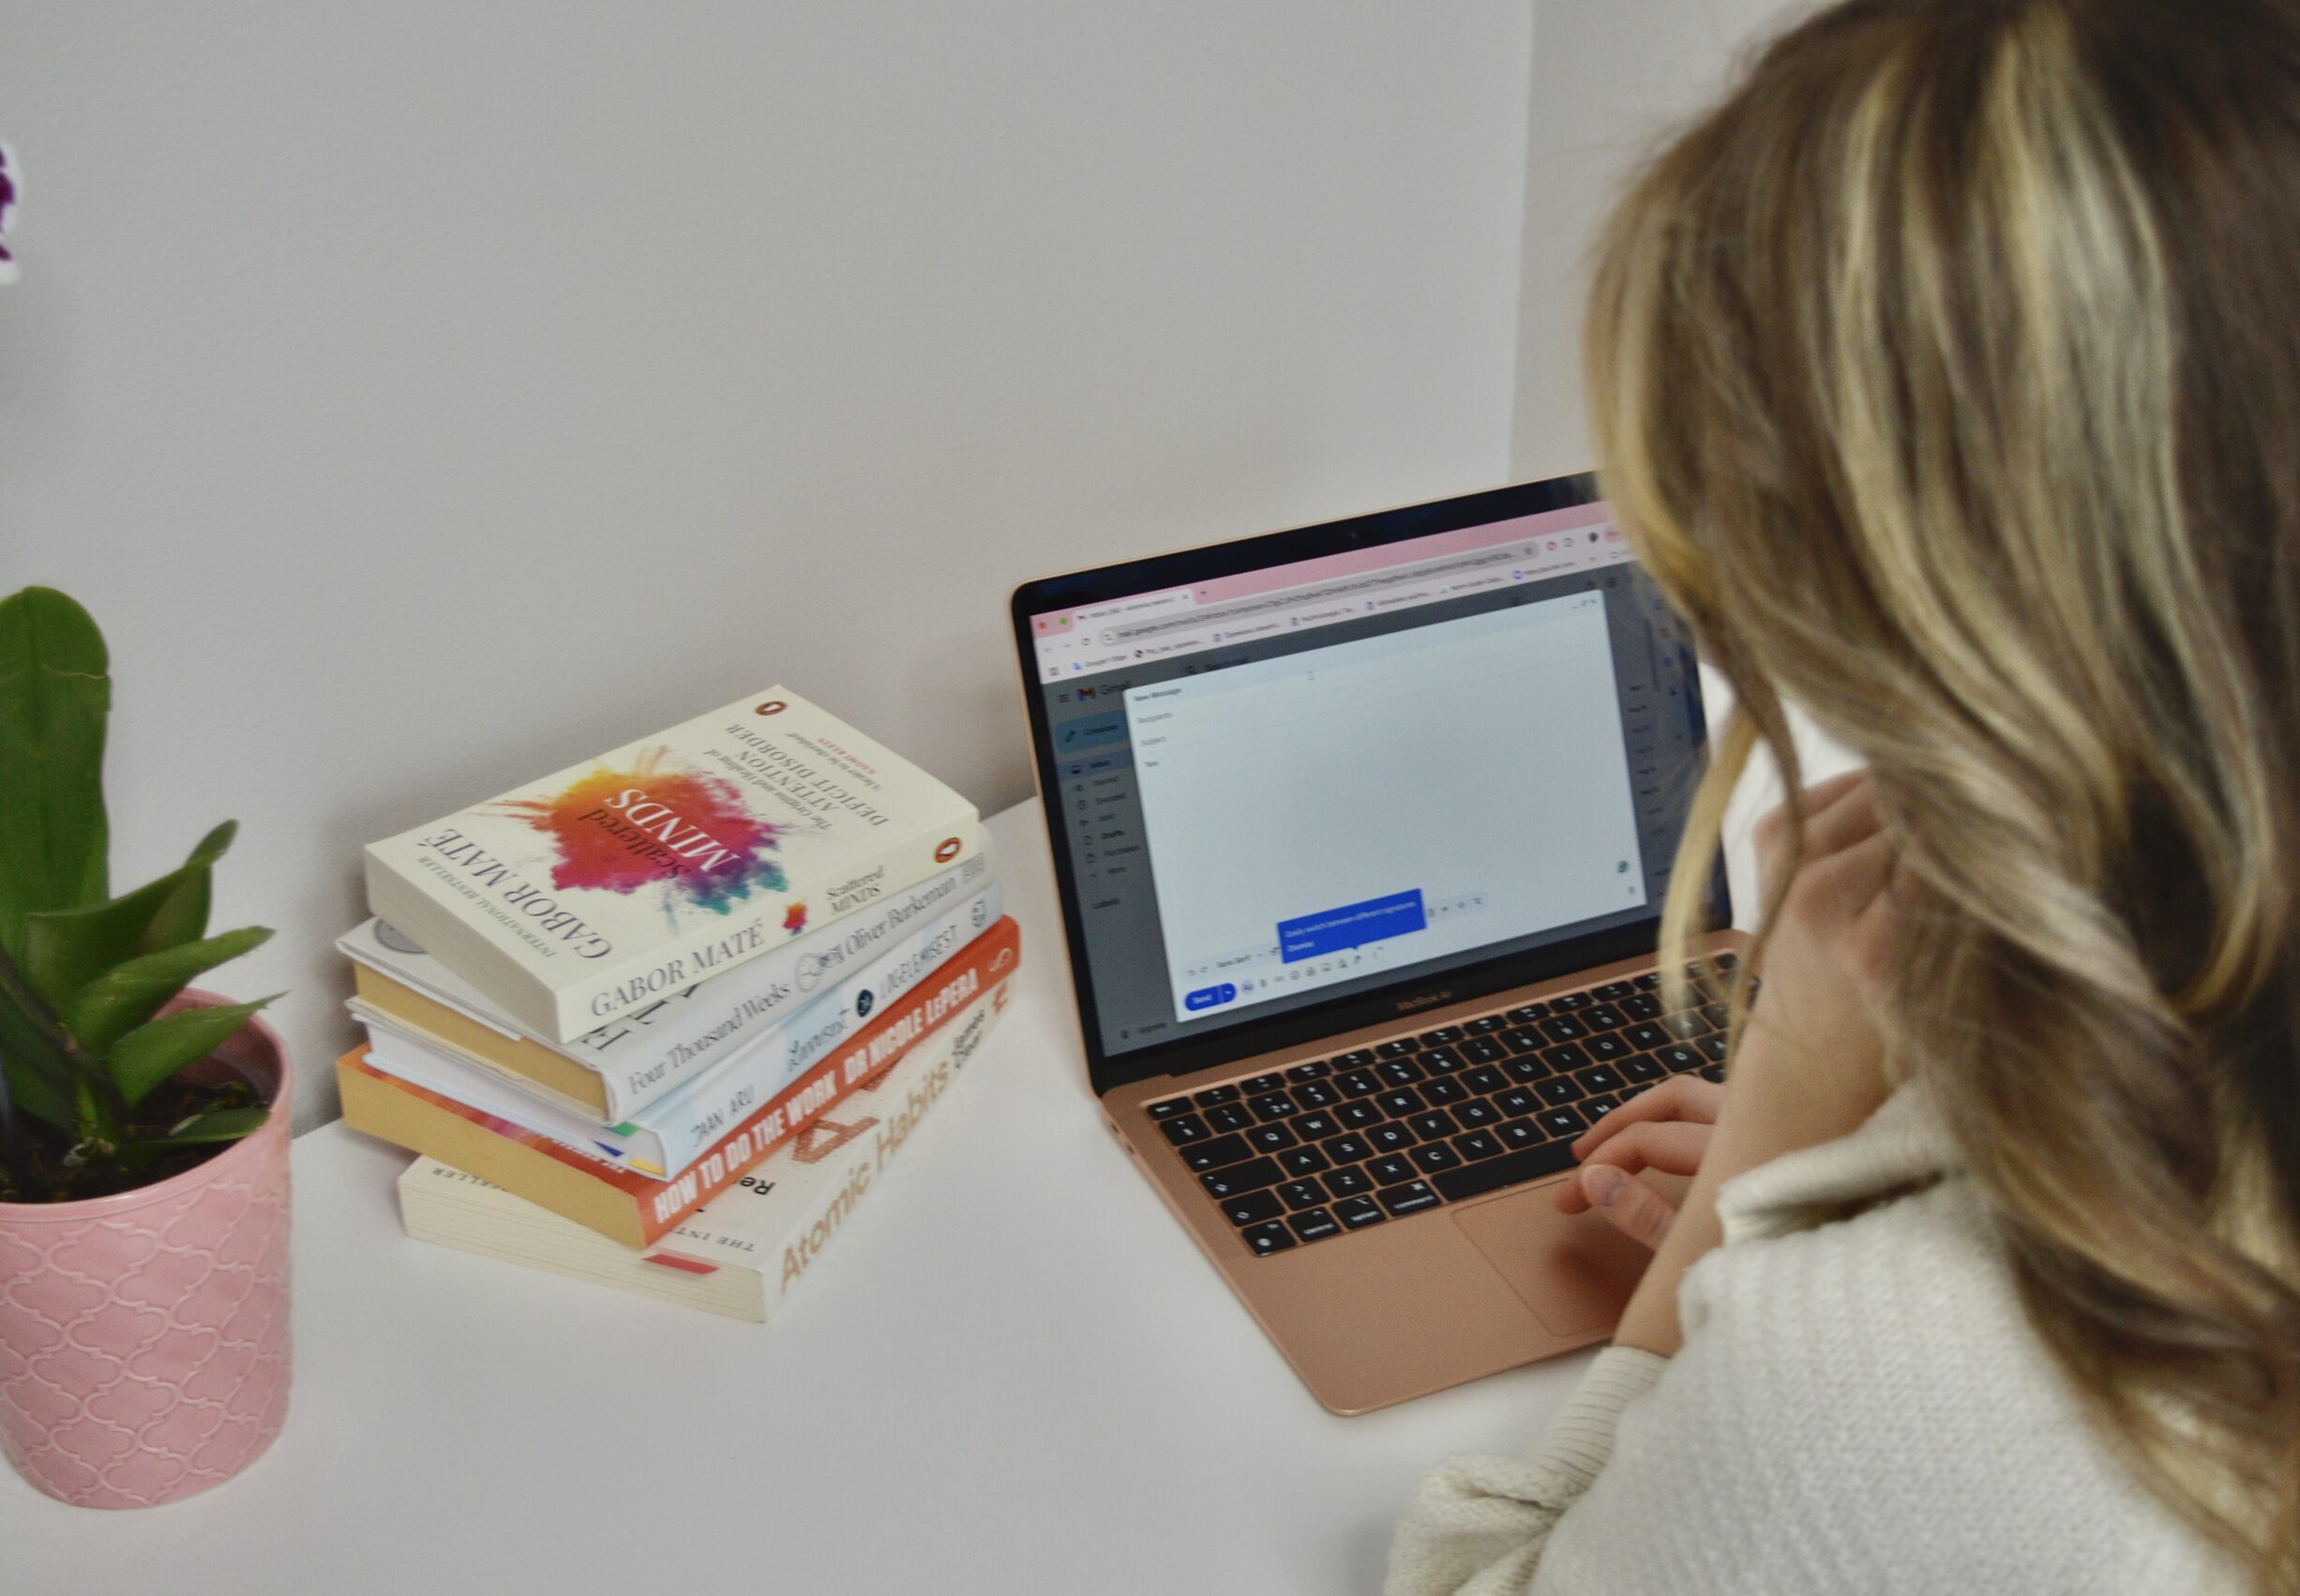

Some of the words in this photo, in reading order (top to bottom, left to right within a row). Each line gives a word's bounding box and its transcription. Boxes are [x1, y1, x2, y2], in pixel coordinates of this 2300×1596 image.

[703, 748, 721, 760] of
[716, 754, 756, 786] Healing
[725, 724, 816, 779] DISORDER
[734, 750, 840, 813] ATTENTION
[752, 774, 776, 793] and
[774, 789, 813, 818] Origins
[813, 774, 890, 827] DEFICIT
[578, 808, 691, 880] Scattered
[604, 789, 742, 873] MINDS
[811, 814, 834, 831] The
[417, 828, 520, 888] MATÉ
[418, 855, 480, 900] BESTSELLER
[825, 865, 884, 900] Scattered
[475, 893, 558, 958] INTERNATIONAL
[502, 881, 613, 960] GABOR
[830, 883, 882, 916] MINDS
[845, 918, 887, 956] Oliver
[886, 877, 957, 929] Burkeman
[591, 959, 686, 1016] GABOR
[691, 917, 766, 973] MATÉ
[628, 1060, 667, 1095] Four
[666, 1006, 744, 1069] Thousand
[742, 983, 791, 1018] Weeks
[843, 1048, 869, 1085] DR
[867, 1008, 924, 1067] NICOLE
[654, 1173, 699, 1224] HOW
[699, 1152, 725, 1189] TO
[724, 1133, 752, 1172] DO
[752, 1107, 786, 1152] THE
[785, 1069, 838, 1126] WORK
[739, 1176, 776, 1197] Re
[780, 1161, 872, 1298] Atomic
[875, 1060, 949, 1172] Habits
[718, 1235, 758, 1253] THE
